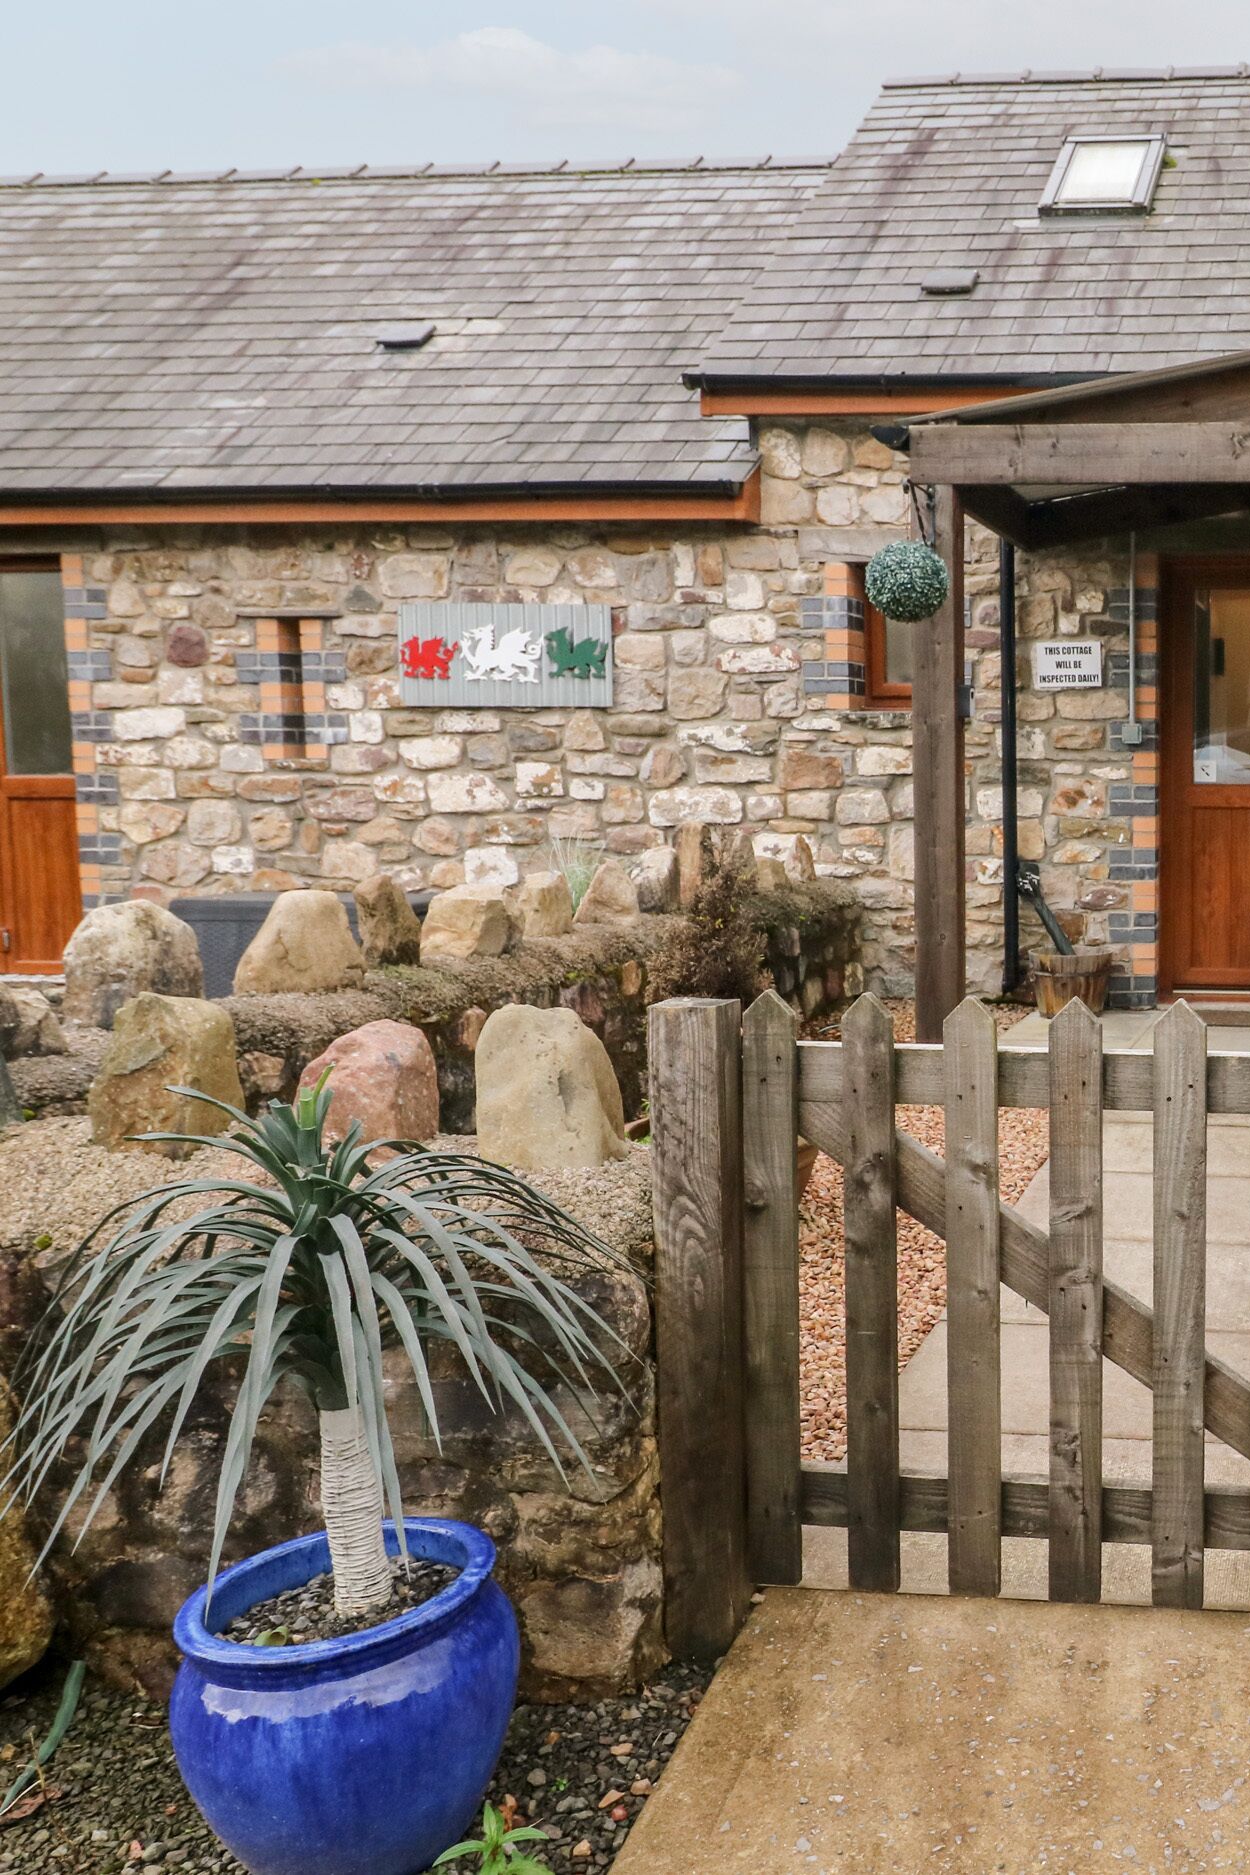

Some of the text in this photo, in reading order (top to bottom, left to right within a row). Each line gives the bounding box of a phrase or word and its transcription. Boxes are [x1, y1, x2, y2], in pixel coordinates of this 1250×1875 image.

[1044, 646, 1092, 655] THIS COTTAGE
[1055, 660, 1082, 669] WILL BE
[1039, 674, 1099, 683] INSPECTED DAILY!
